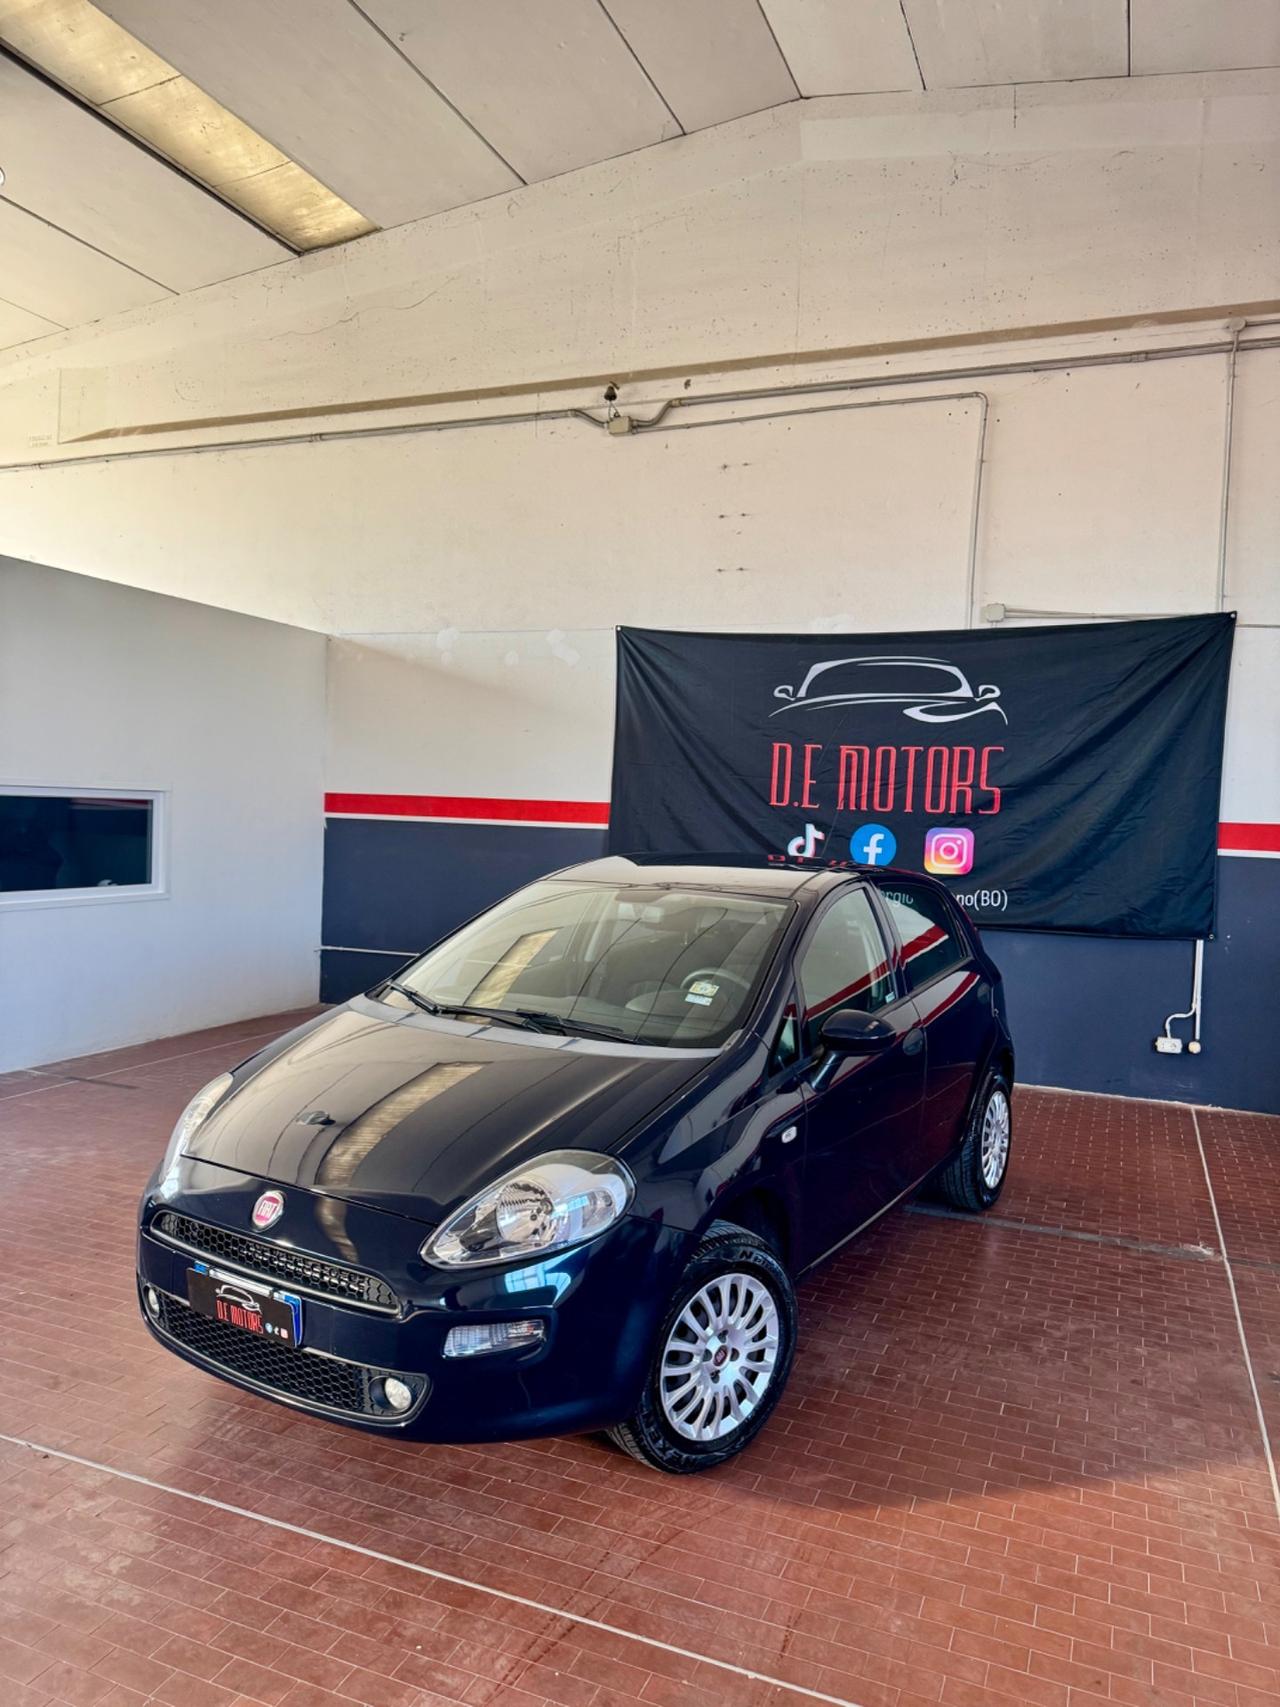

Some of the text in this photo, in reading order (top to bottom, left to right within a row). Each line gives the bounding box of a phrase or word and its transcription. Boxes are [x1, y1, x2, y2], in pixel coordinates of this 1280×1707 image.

[769, 742, 1005, 815] D.E MOTORS
[257, 1200, 279, 1218] FIAT
[231, 1306, 263, 1334] MOTORS
